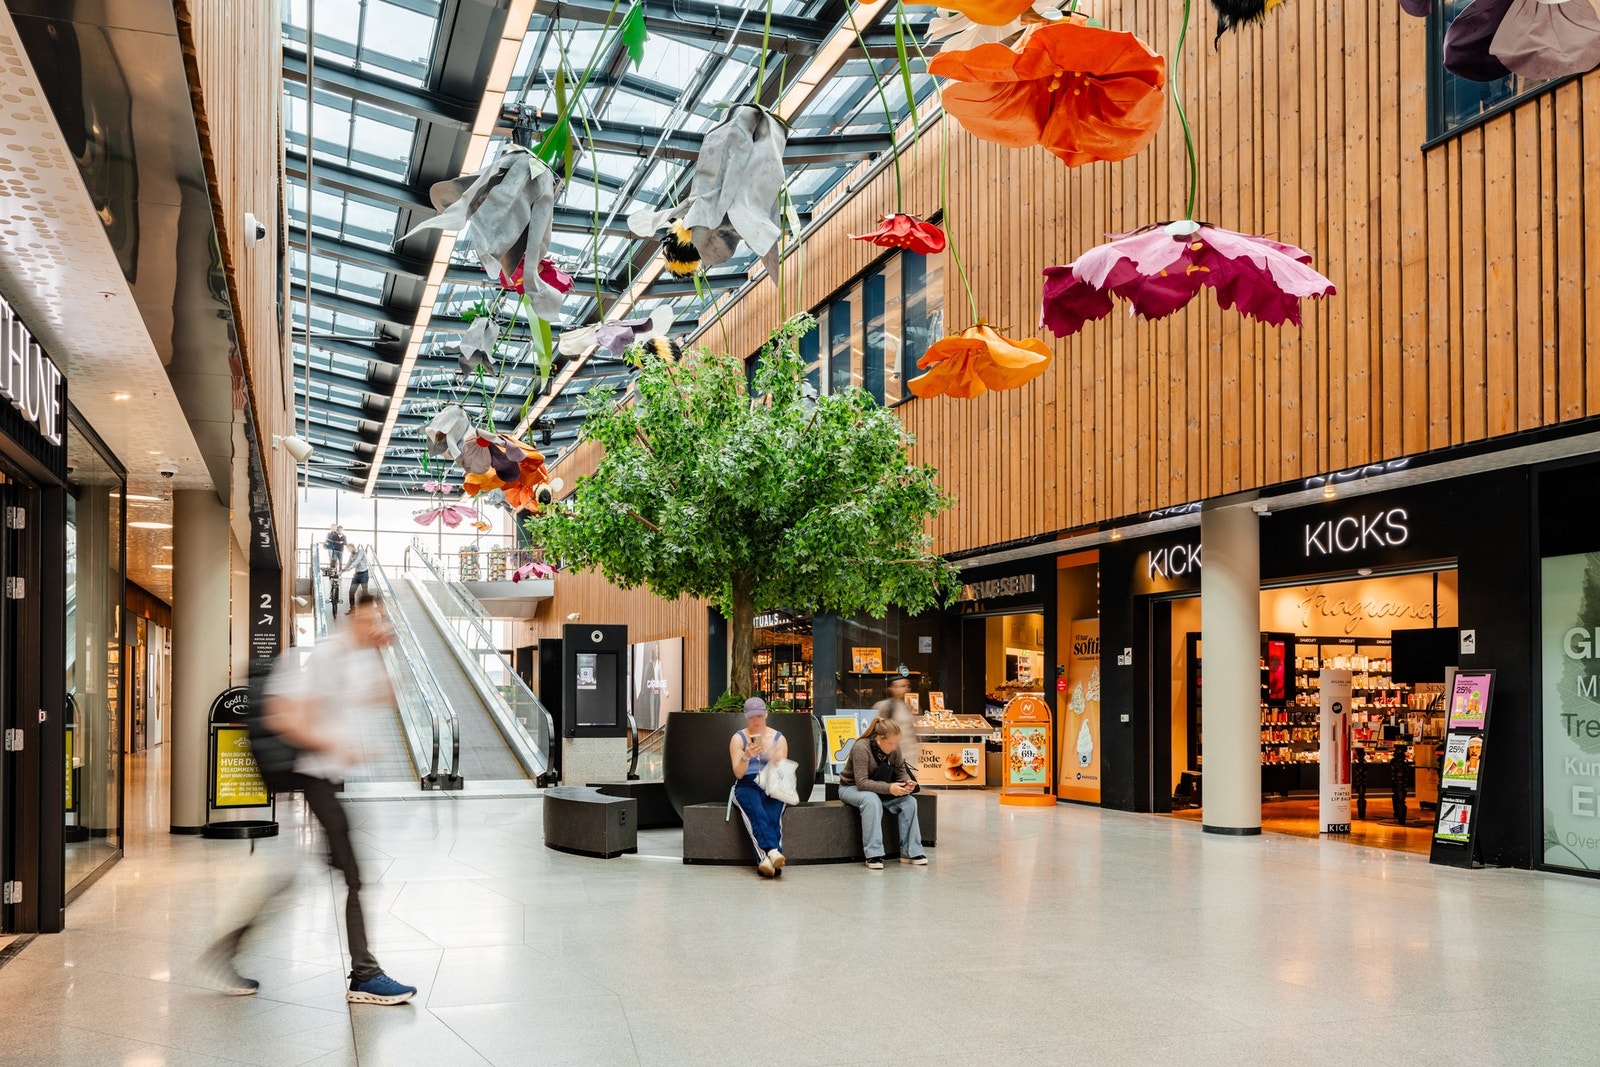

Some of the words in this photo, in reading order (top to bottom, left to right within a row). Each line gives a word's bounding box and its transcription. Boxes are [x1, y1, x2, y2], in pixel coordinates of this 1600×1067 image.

[1305, 508, 1409, 557] KICKS
[260, 594, 272, 609] 2
[1073, 637, 1100, 656] softi
[1456, 686, 1472, 694] 25%
[1577, 675, 1600, 697] M
[224, 694, 241, 709] Godt
[1560, 713, 1600, 738] Tre
[1448, 745, 1465, 754] 25%
[221, 758, 244, 766] HVER
[918, 755, 940, 764] gode
